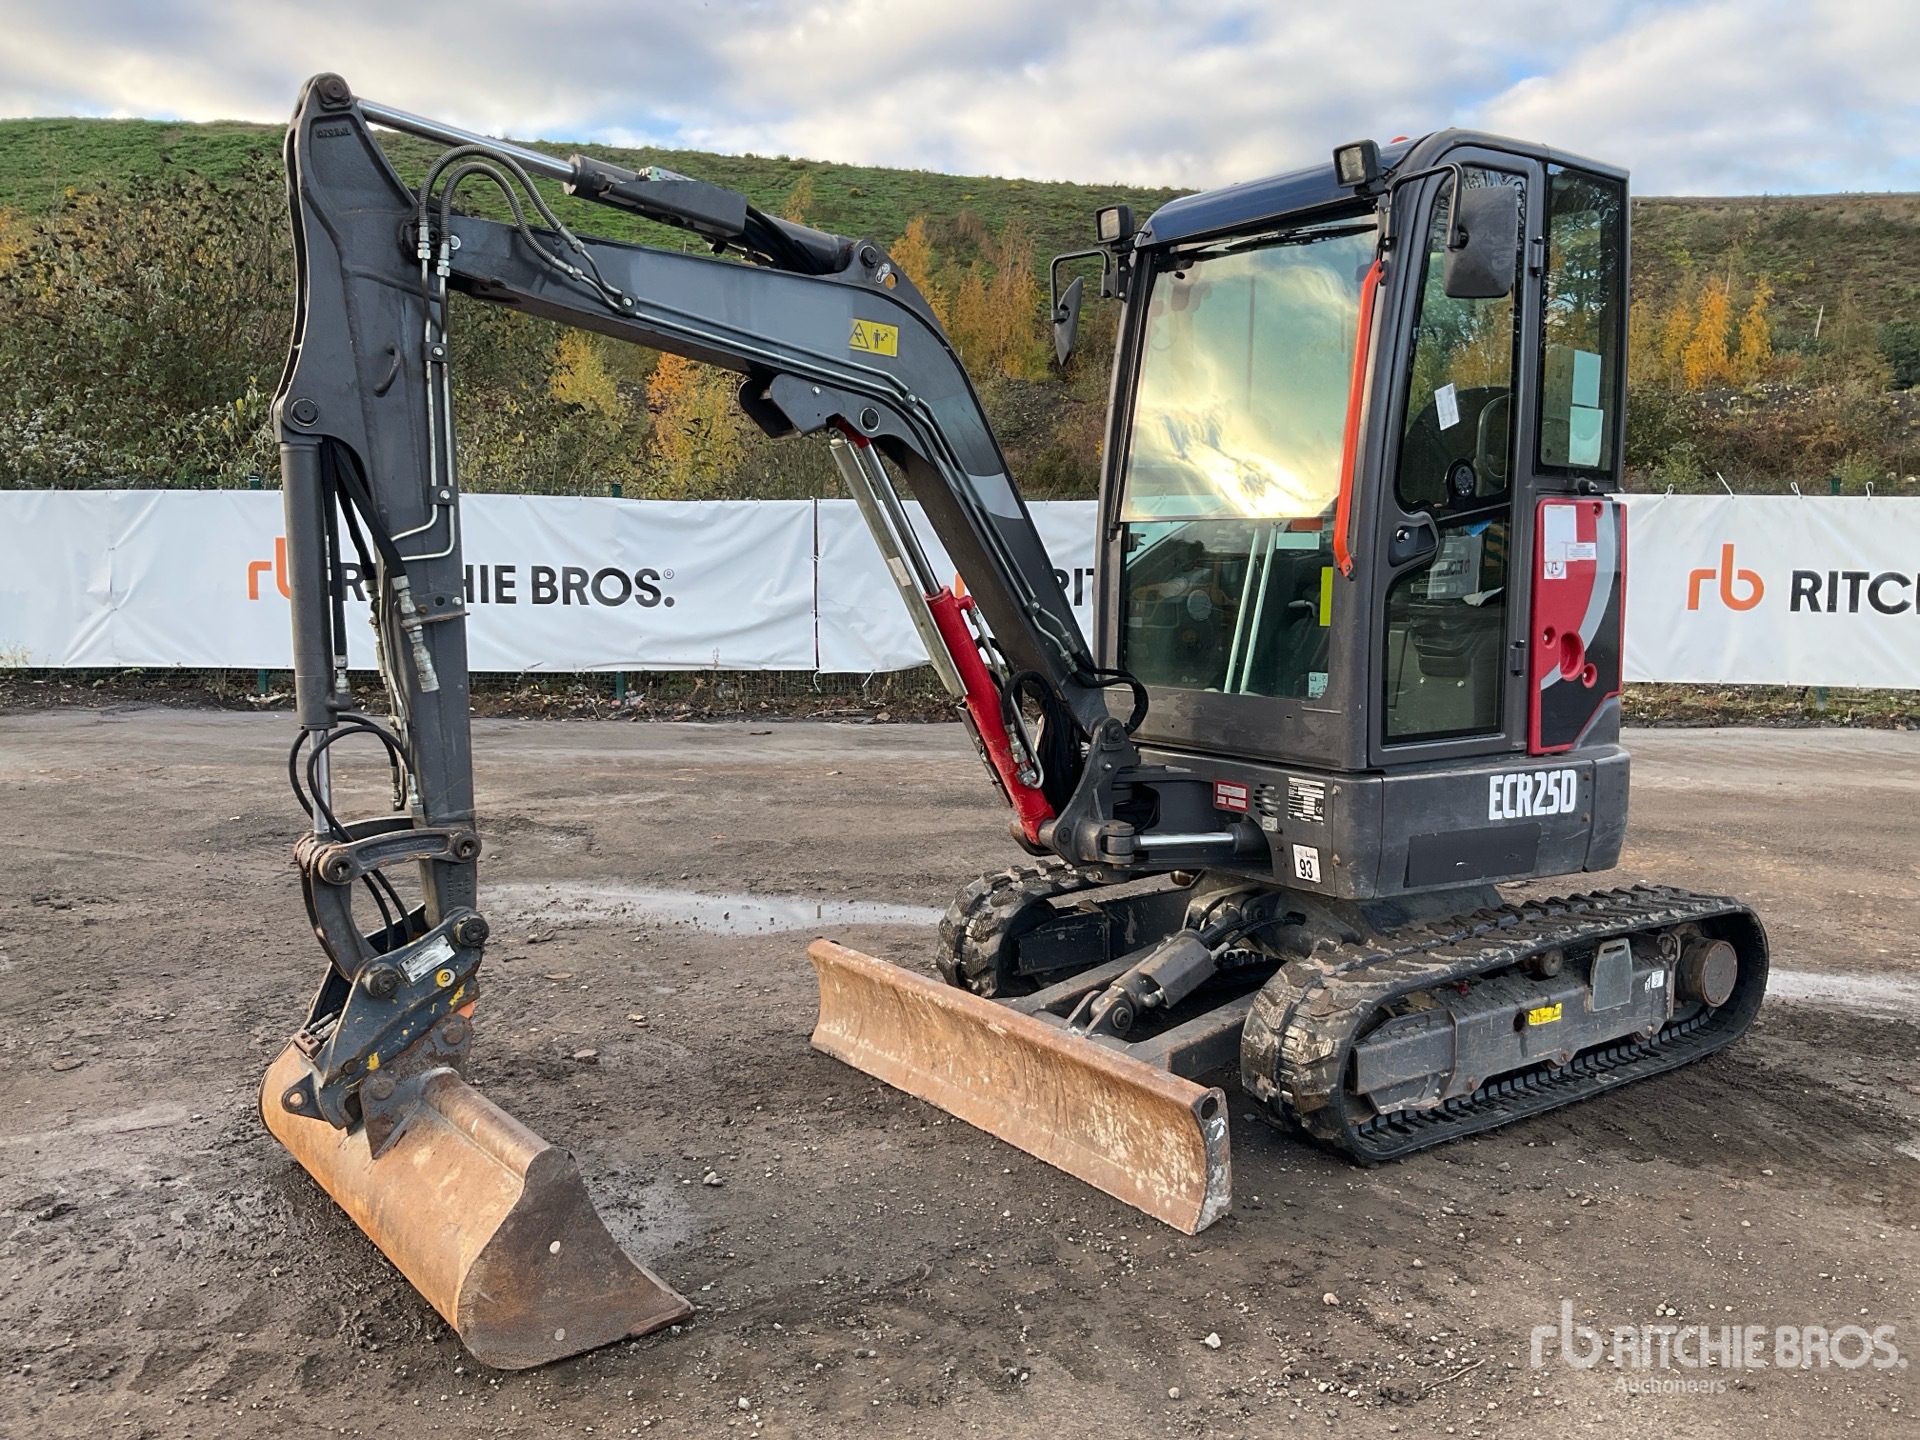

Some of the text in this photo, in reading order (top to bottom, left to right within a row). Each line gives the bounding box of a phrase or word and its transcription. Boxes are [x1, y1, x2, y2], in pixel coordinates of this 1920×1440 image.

[1790, 569, 1920, 615] RITC
[1488, 769, 1577, 820] ECR25D
[1300, 858, 1313, 879] 93
